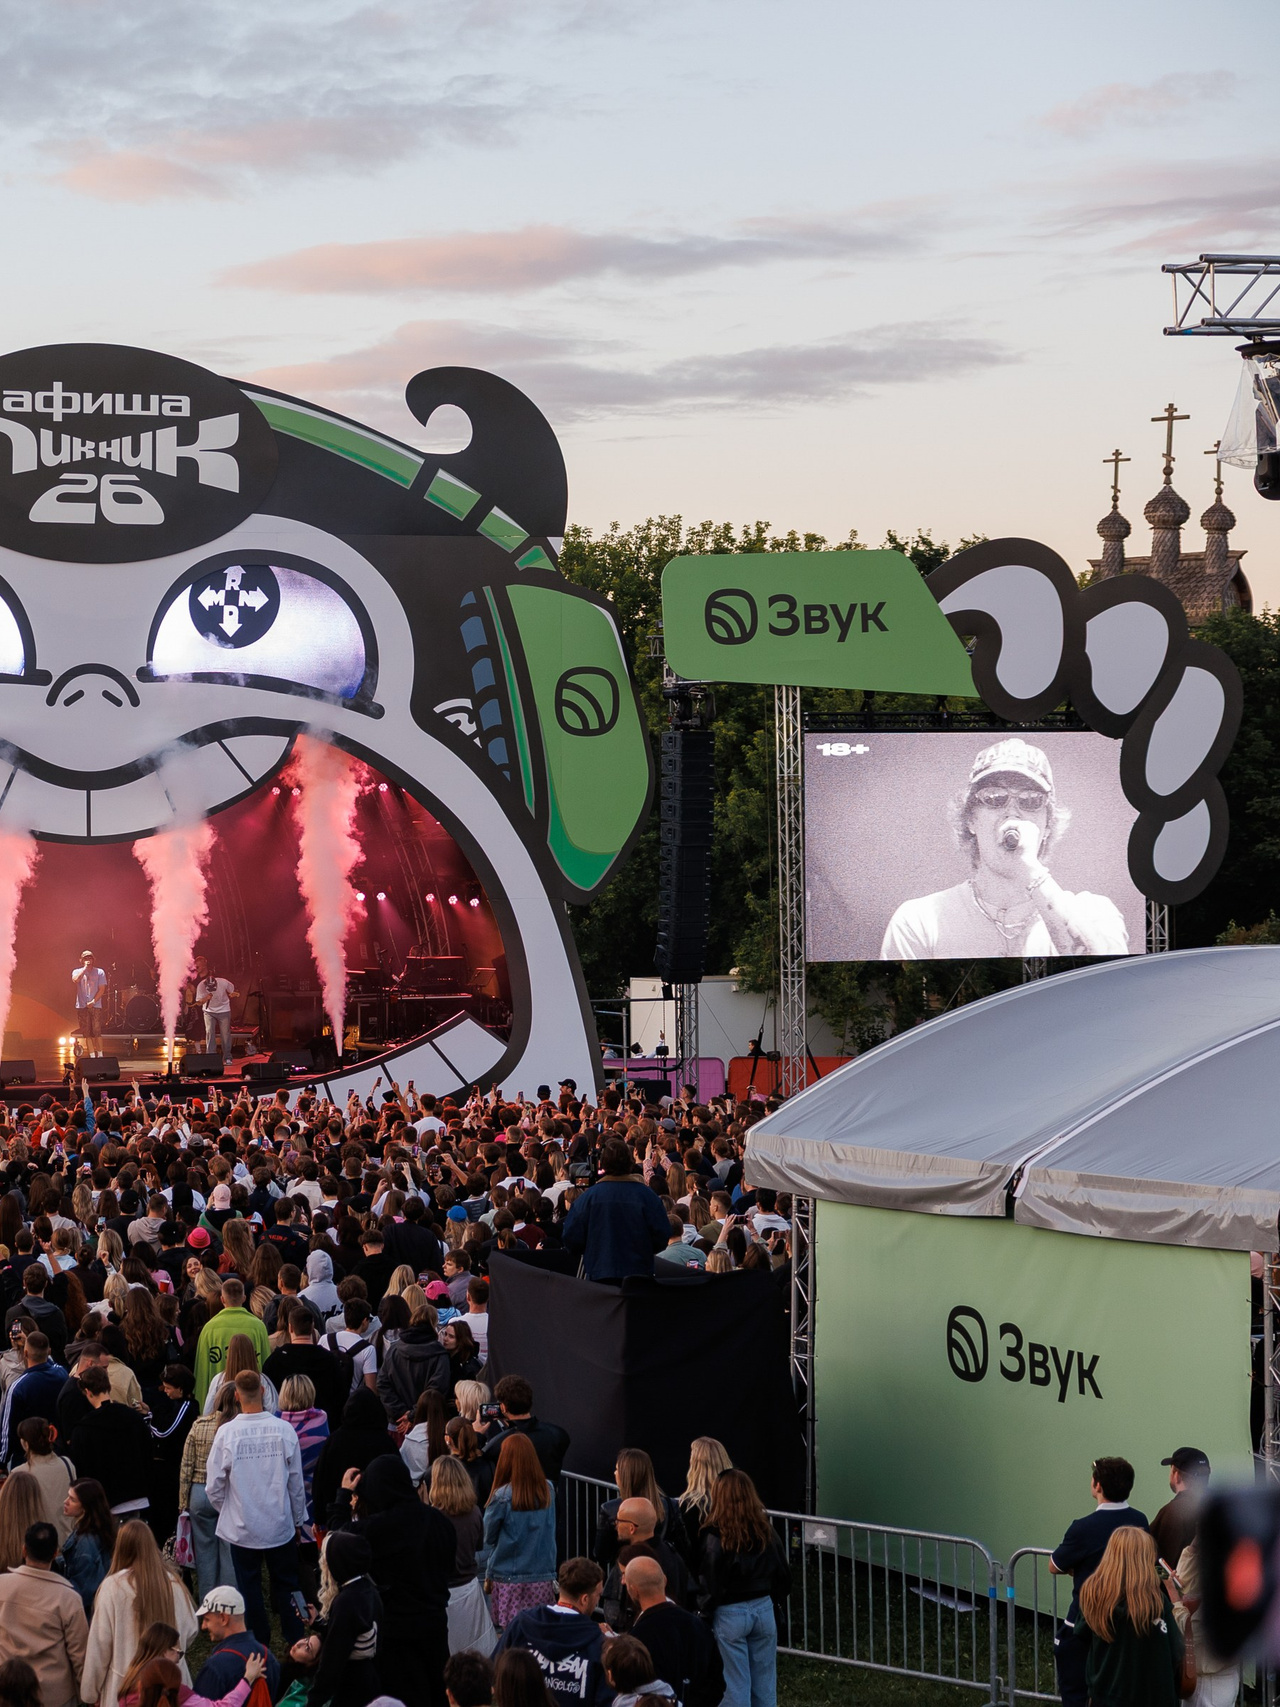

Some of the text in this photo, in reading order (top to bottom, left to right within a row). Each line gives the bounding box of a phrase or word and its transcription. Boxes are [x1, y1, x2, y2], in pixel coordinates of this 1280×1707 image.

[2, 381, 191, 422] афиша
[28, 472, 165, 525] 26
[768, 593, 890, 643] Звук
[816, 743, 870, 756] 18+
[999, 1322, 1104, 1403] Звук
